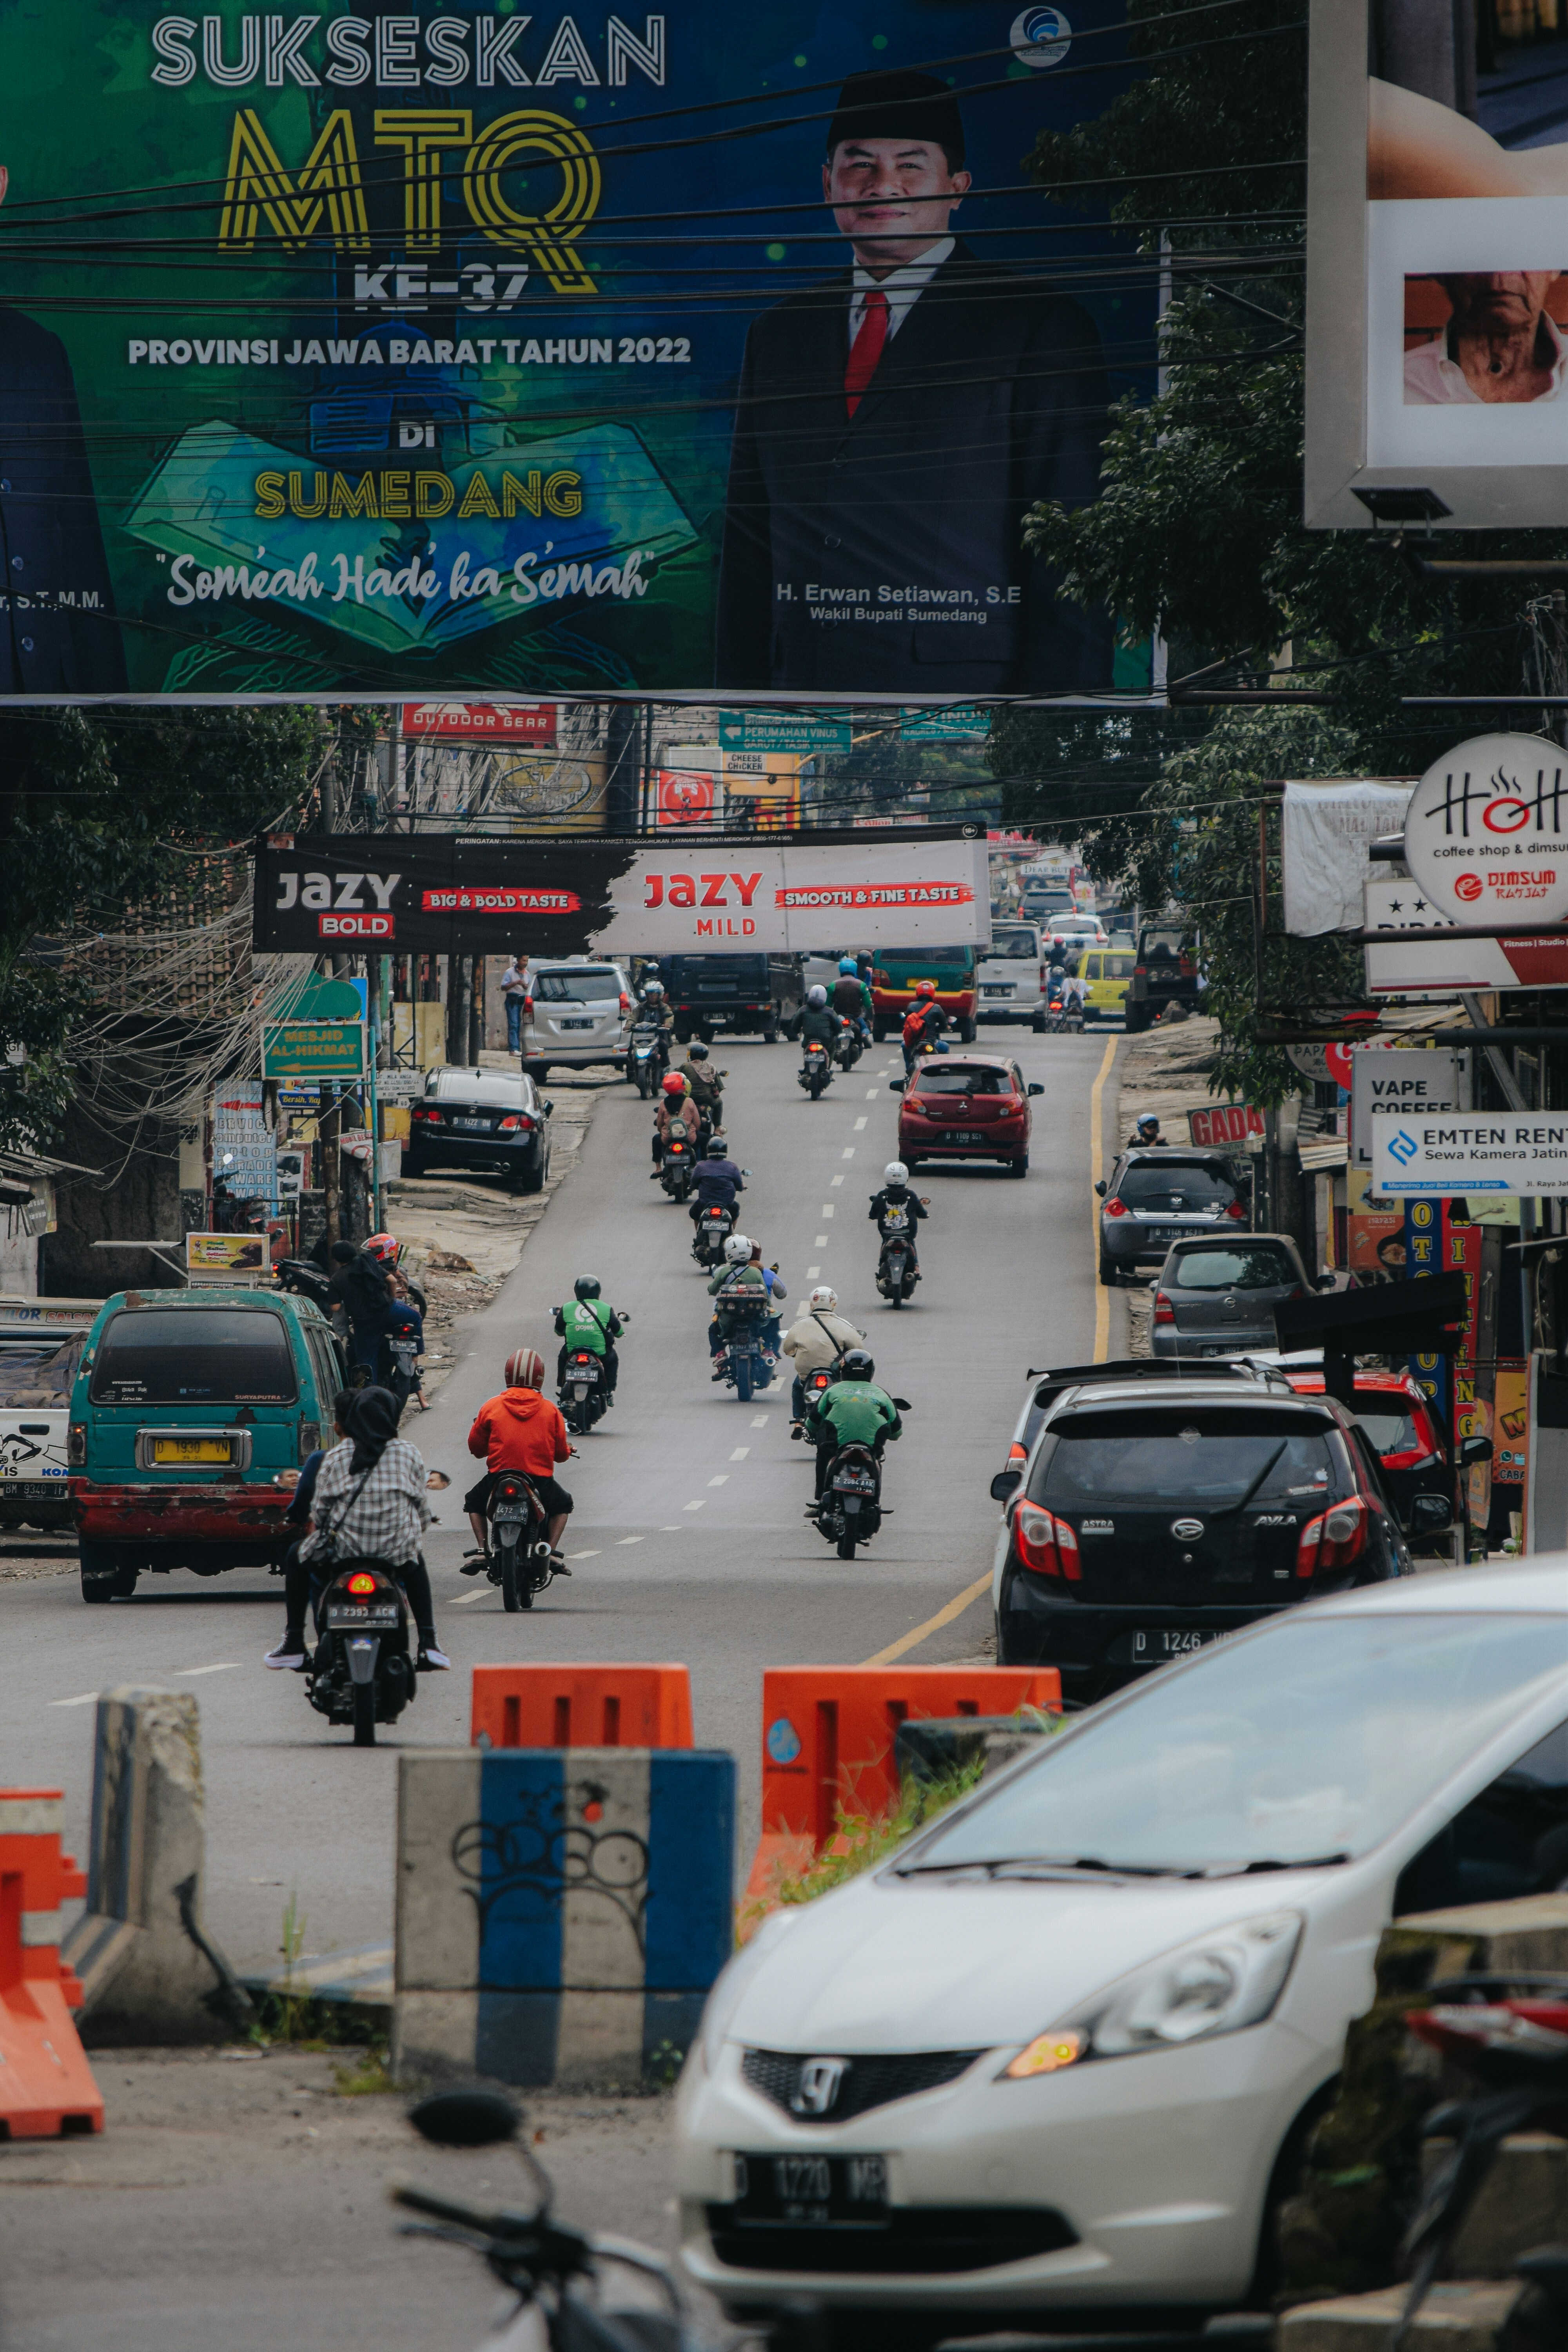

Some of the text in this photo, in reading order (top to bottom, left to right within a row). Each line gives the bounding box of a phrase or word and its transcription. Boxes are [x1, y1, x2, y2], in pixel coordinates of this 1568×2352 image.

[151, 15, 665, 86] SUKSESKAN
[218, 109, 601, 293] MTQ
[354, 263, 529, 312] KE-37
[128, 338, 691, 365] PROVINSI JAWA BARAT TAHUN 2022
[399, 421, 435, 447] DI
[254, 470, 582, 519] SUMEDANG
[450, 552, 506, 601] ka
[777, 584, 1022, 606] H. Erwan Setiawan, S.E
[810, 607, 987, 624] Wakil Bupati Sumedang
[414, 713, 548, 728] OUTDOOR GEAR
[745, 727, 838, 738] PERUMAHAN VINUS
[744, 739, 776, 749] GARUT
[784, 739, 811, 750] TASIK
[1434, 845, 1475, 857] coffee
[1479, 844, 1510, 857] shop
[1514, 844, 1524, 854] &
[1488, 870, 1556, 886] DIMSUM
[430, 894, 568, 908] BIG & BOLD TASTE
[785, 887, 959, 906] SMOOTH & FINE TASTE
[322, 918, 388, 934] BOLD
[697, 918, 756, 936] MILD
[1504, 940, 1533, 948] Fitness
[1538, 938, 1565, 946] Studio
[284, 1030, 343, 1042] MESJID
[271, 1044, 356, 1056] AL-HIKMAT
[1372, 1080, 1427, 1095] VAPE
[214, 1118, 266, 1129] ERVIC
[216, 1132, 273, 1143] omputer
[1424, 1127, 1568, 1145] EMTEN REN
[216, 1147, 273, 1159] aptop
[1425, 1148, 1568, 1160] Sewa Kamera Jatin
[157, 1440, 228, 1454] D 1930 VN
[24, 1484, 46, 1494] 9340
[54, 1484, 64, 1495] TF
[1136, 1632, 1146, 1651] D
[1163, 1632, 1201, 1651] 1246
